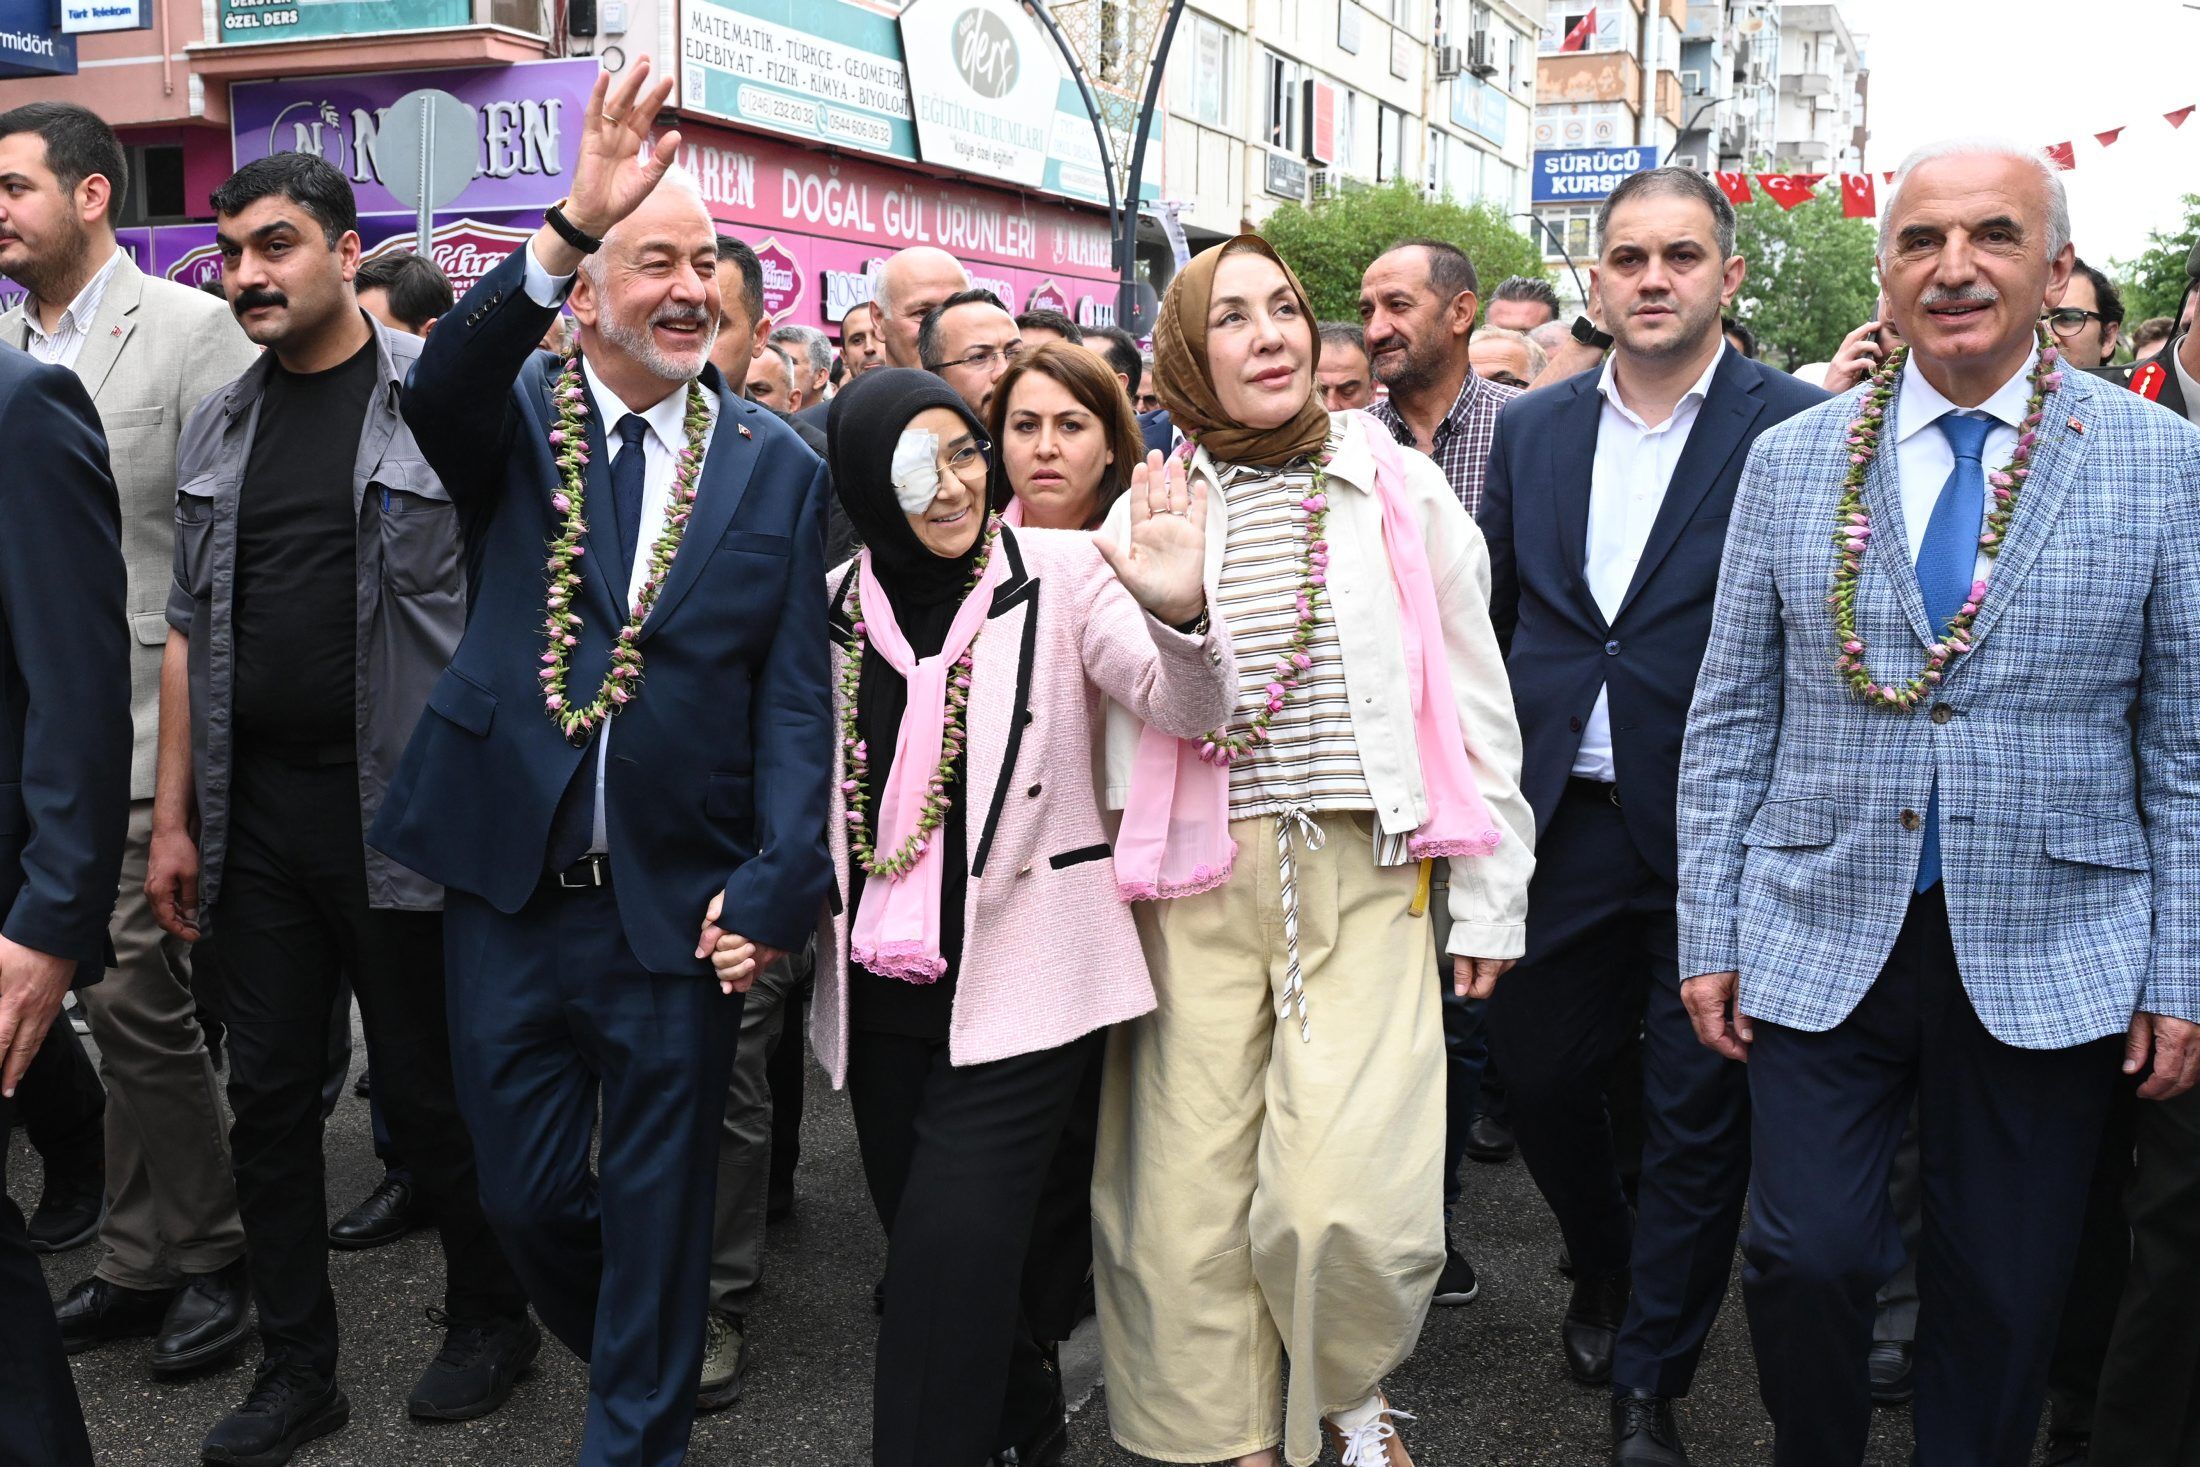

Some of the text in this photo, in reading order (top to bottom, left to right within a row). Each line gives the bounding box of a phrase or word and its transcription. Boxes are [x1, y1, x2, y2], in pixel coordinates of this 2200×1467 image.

[224, 10, 299, 29] ÖZEL DERS
[0, 31, 54, 57] midört
[685, 37, 754, 74] EDEBİYAT
[691, 11, 774, 53] MATEMATİK
[786, 37, 833, 73] TÜRKÇE
[350, 97, 564, 187] NEN
[773, 99, 790, 120] 232
[790, 104, 802, 121] 20
[803, 107, 814, 124] 32
[880, 126, 890, 142] 32
[973, 110, 1045, 153] KURUMLARI
[1544, 150, 1642, 175] SÜRÜCÜ
[781, 165, 876, 233] DOĞAL
[882, 184, 930, 242] GÜL
[935, 191, 1036, 260] ÜRÜNLERİ
